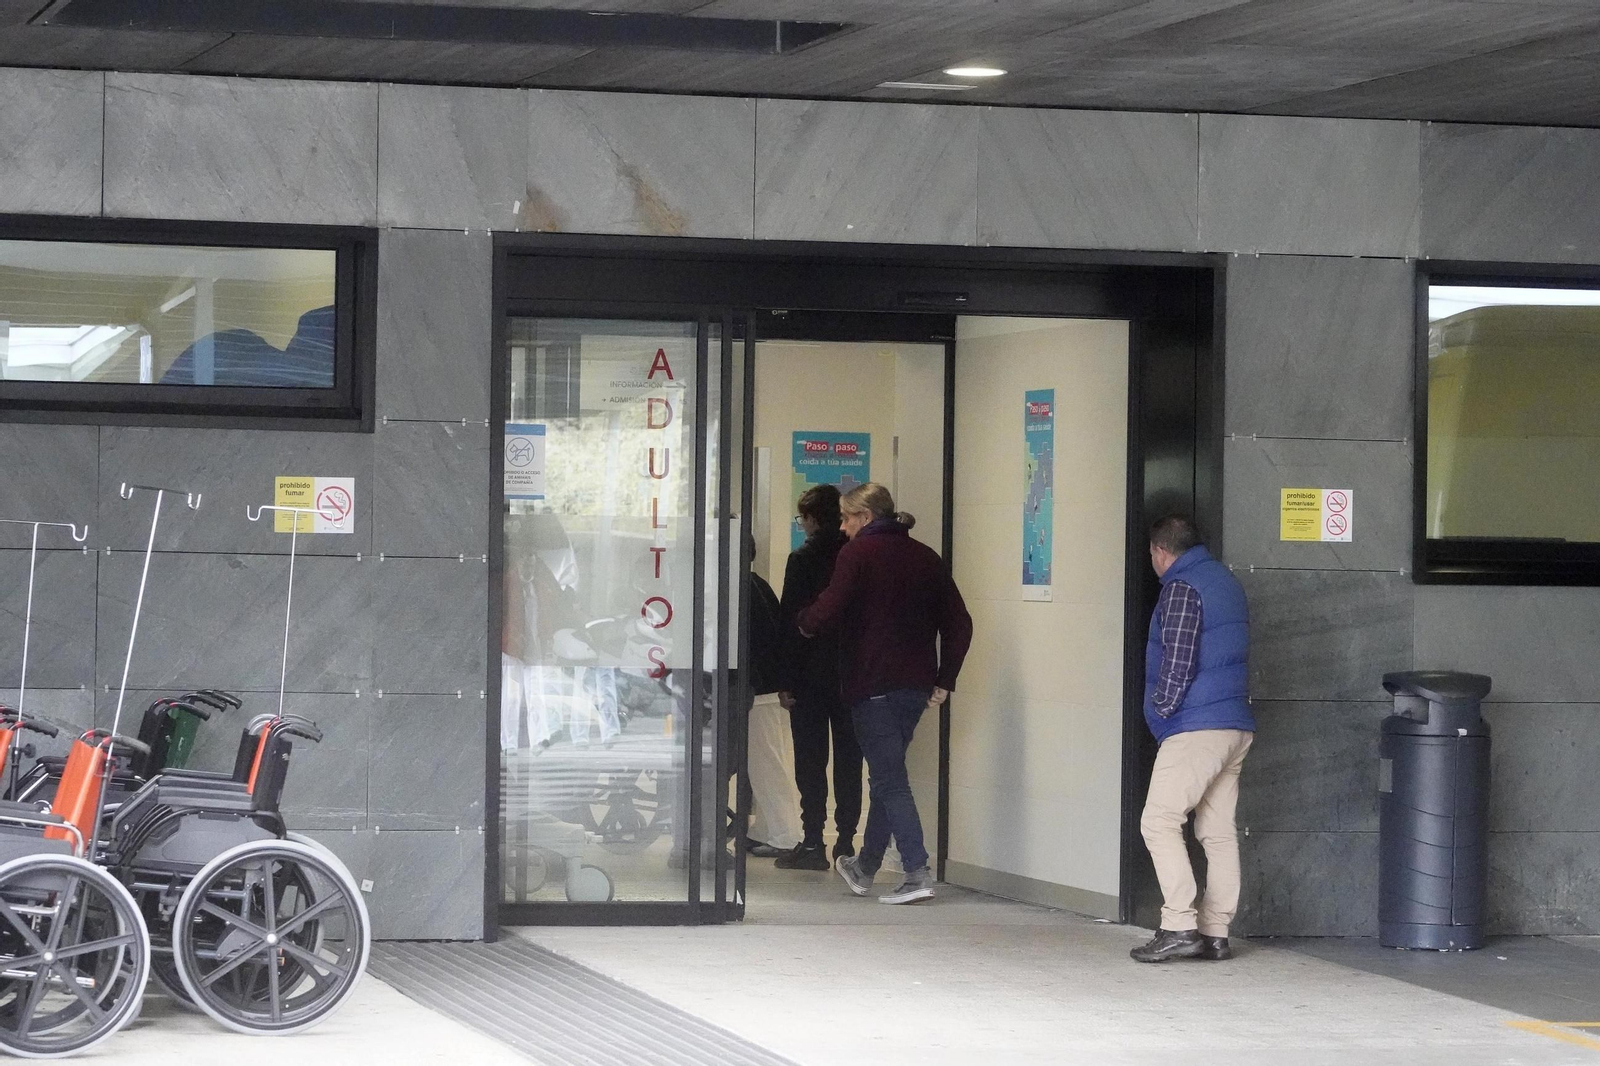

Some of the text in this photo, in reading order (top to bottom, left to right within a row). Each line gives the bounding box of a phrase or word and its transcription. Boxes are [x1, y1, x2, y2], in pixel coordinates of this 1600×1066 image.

[641, 348, 674, 679] ADULTOS
[806, 442, 827, 451] Paso
[835, 444, 857, 452] paso
